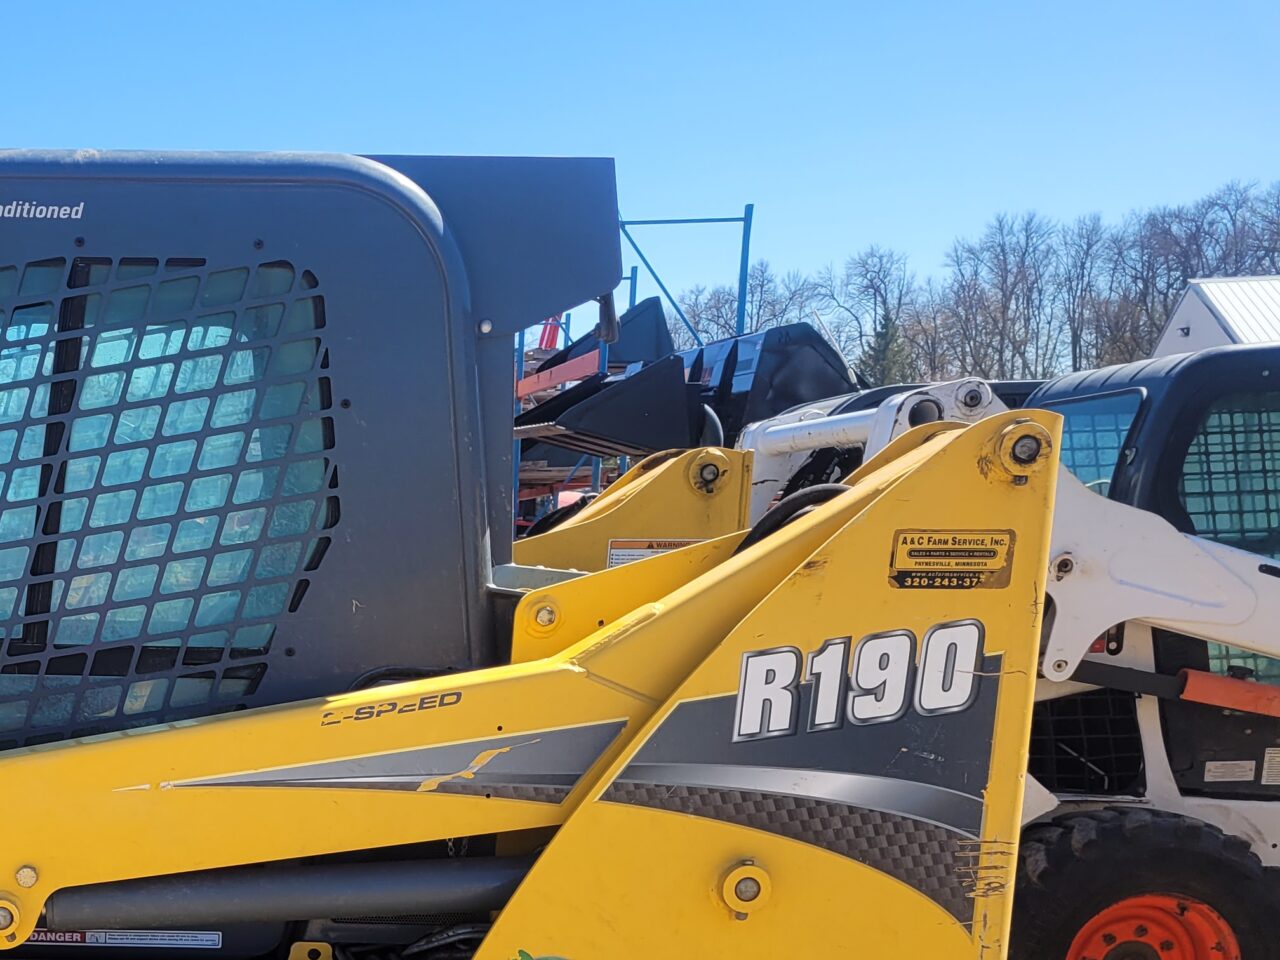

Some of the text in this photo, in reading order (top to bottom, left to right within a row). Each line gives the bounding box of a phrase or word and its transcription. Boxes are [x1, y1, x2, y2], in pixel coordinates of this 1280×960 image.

[901, 536, 908, 546] A
[909, 536, 916, 546] &
[917, 536, 925, 546] C
[732, 618, 986, 743] R190
[29, 932, 82, 942] DANGER
